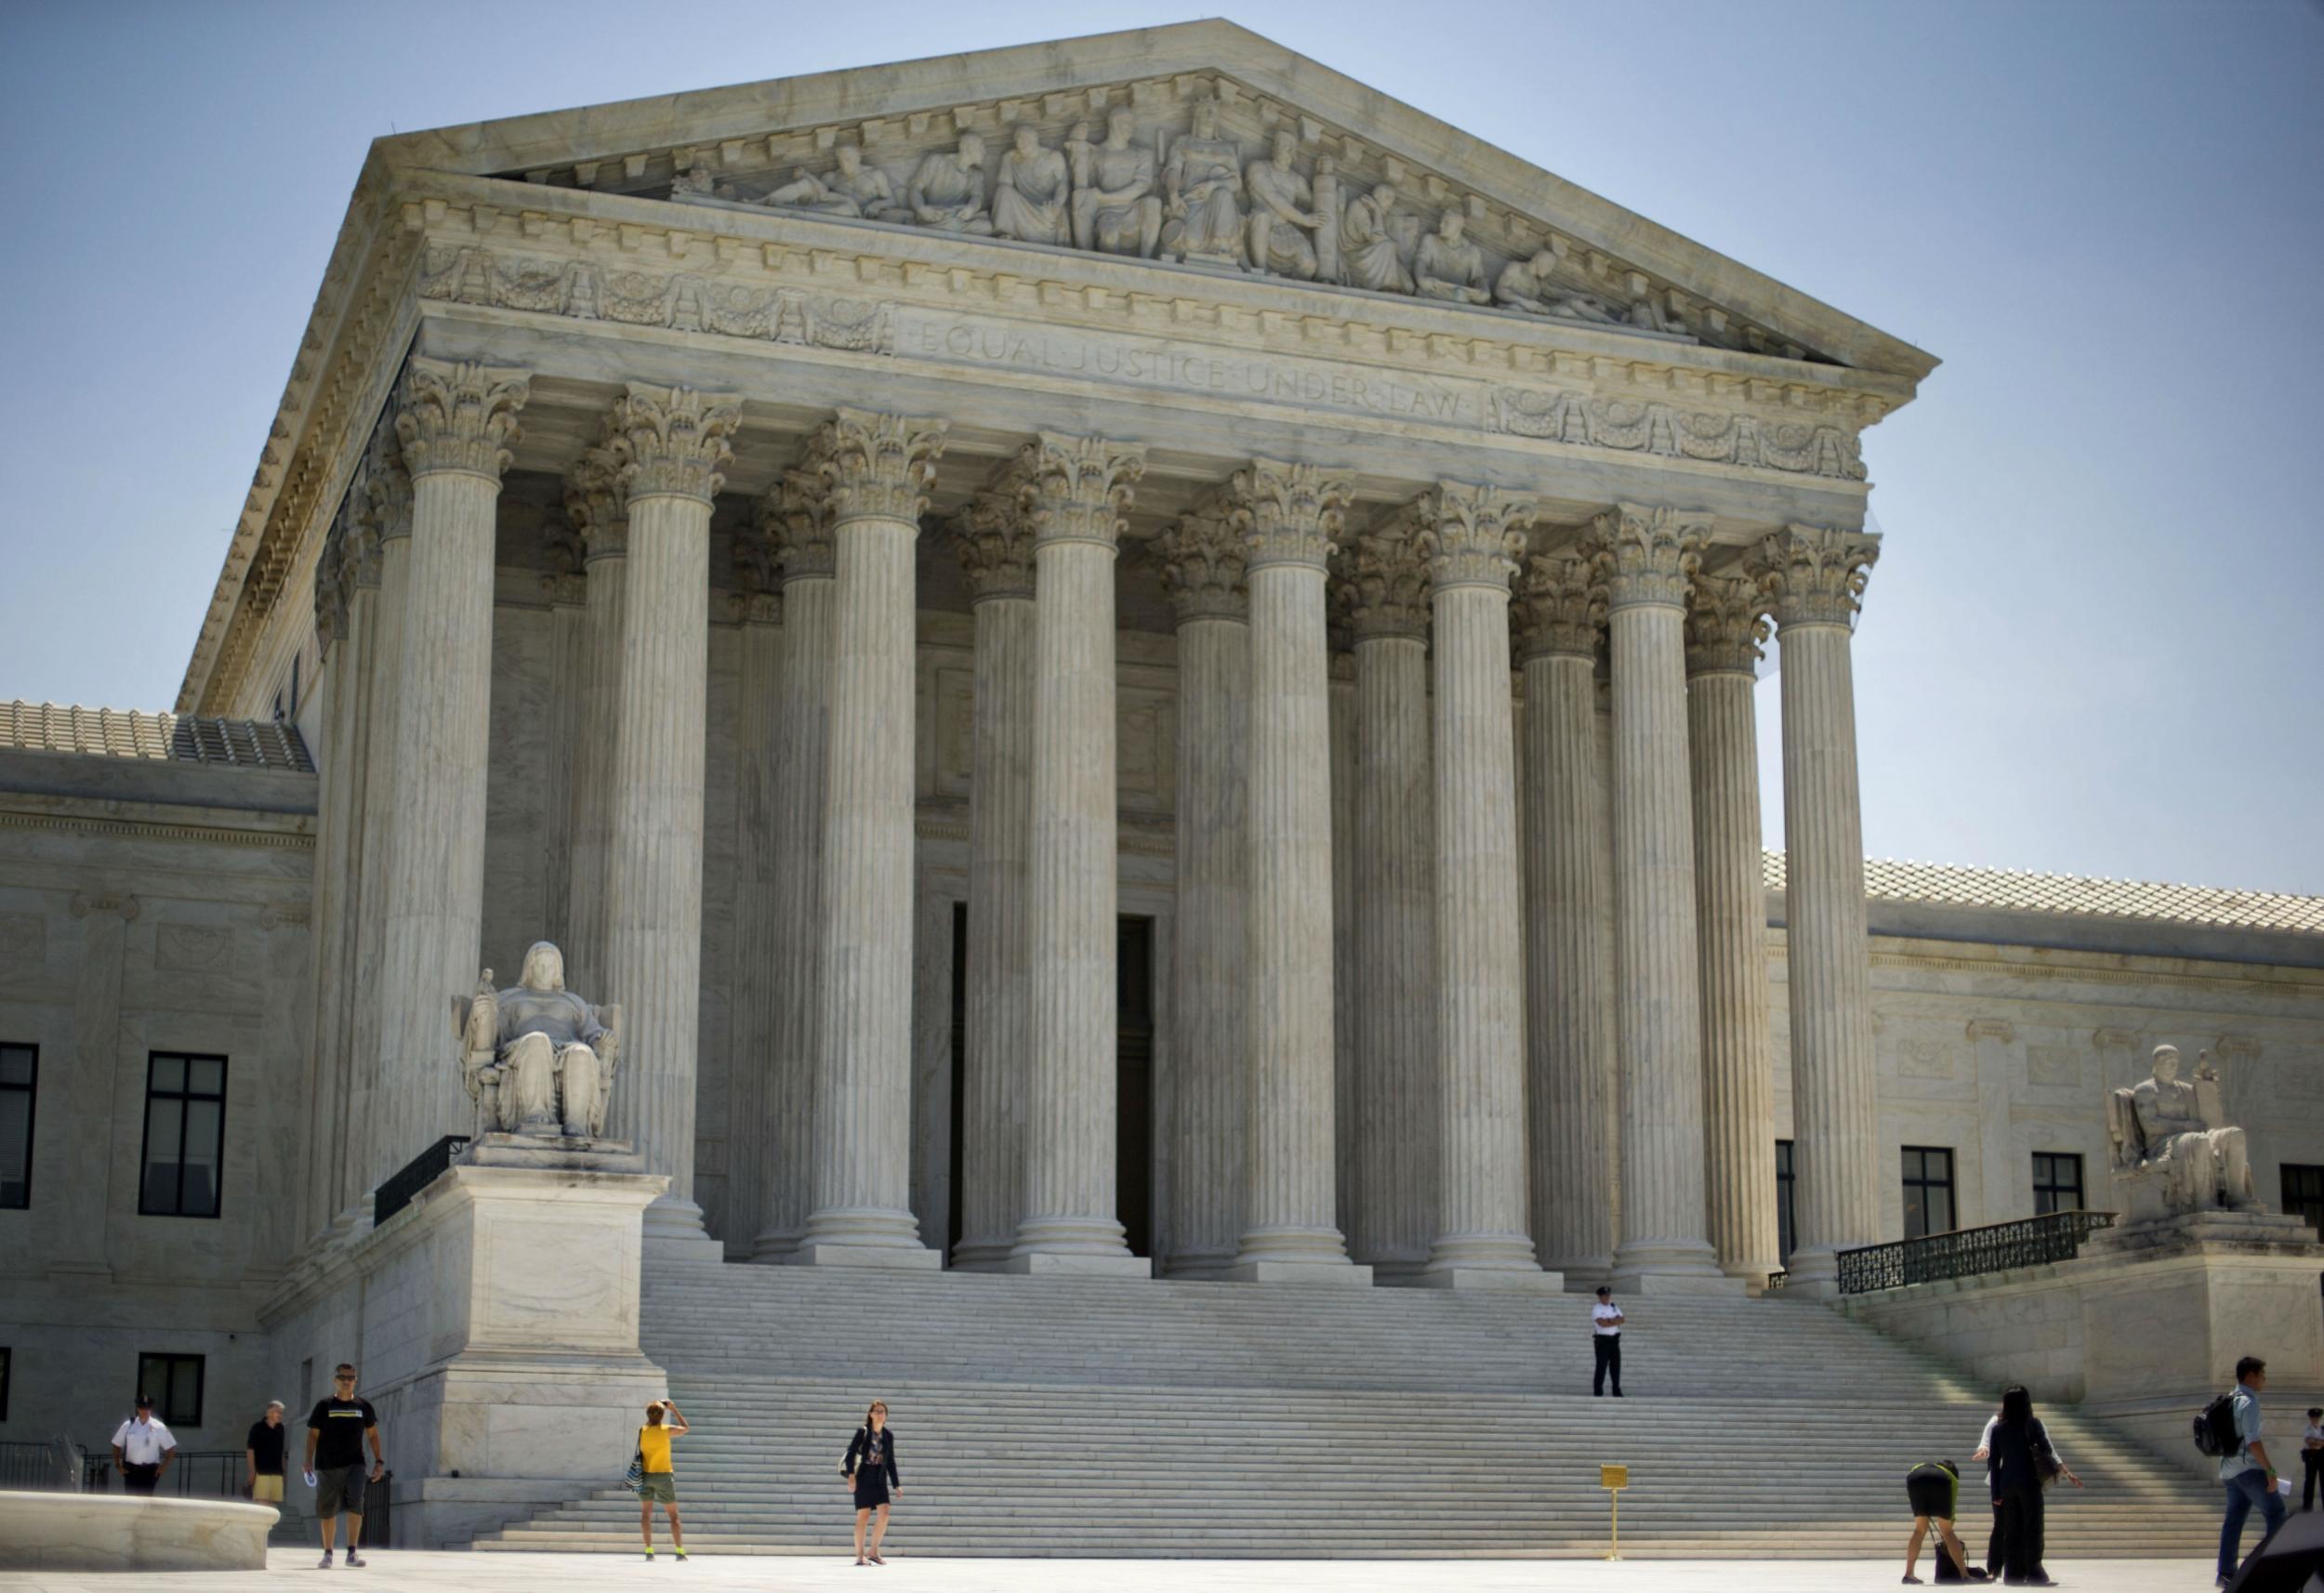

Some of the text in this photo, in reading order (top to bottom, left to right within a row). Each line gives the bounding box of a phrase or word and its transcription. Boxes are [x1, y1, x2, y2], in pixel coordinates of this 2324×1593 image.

[921, 323, 1459, 417] EQUAL JUSTICE UNDER LAW
